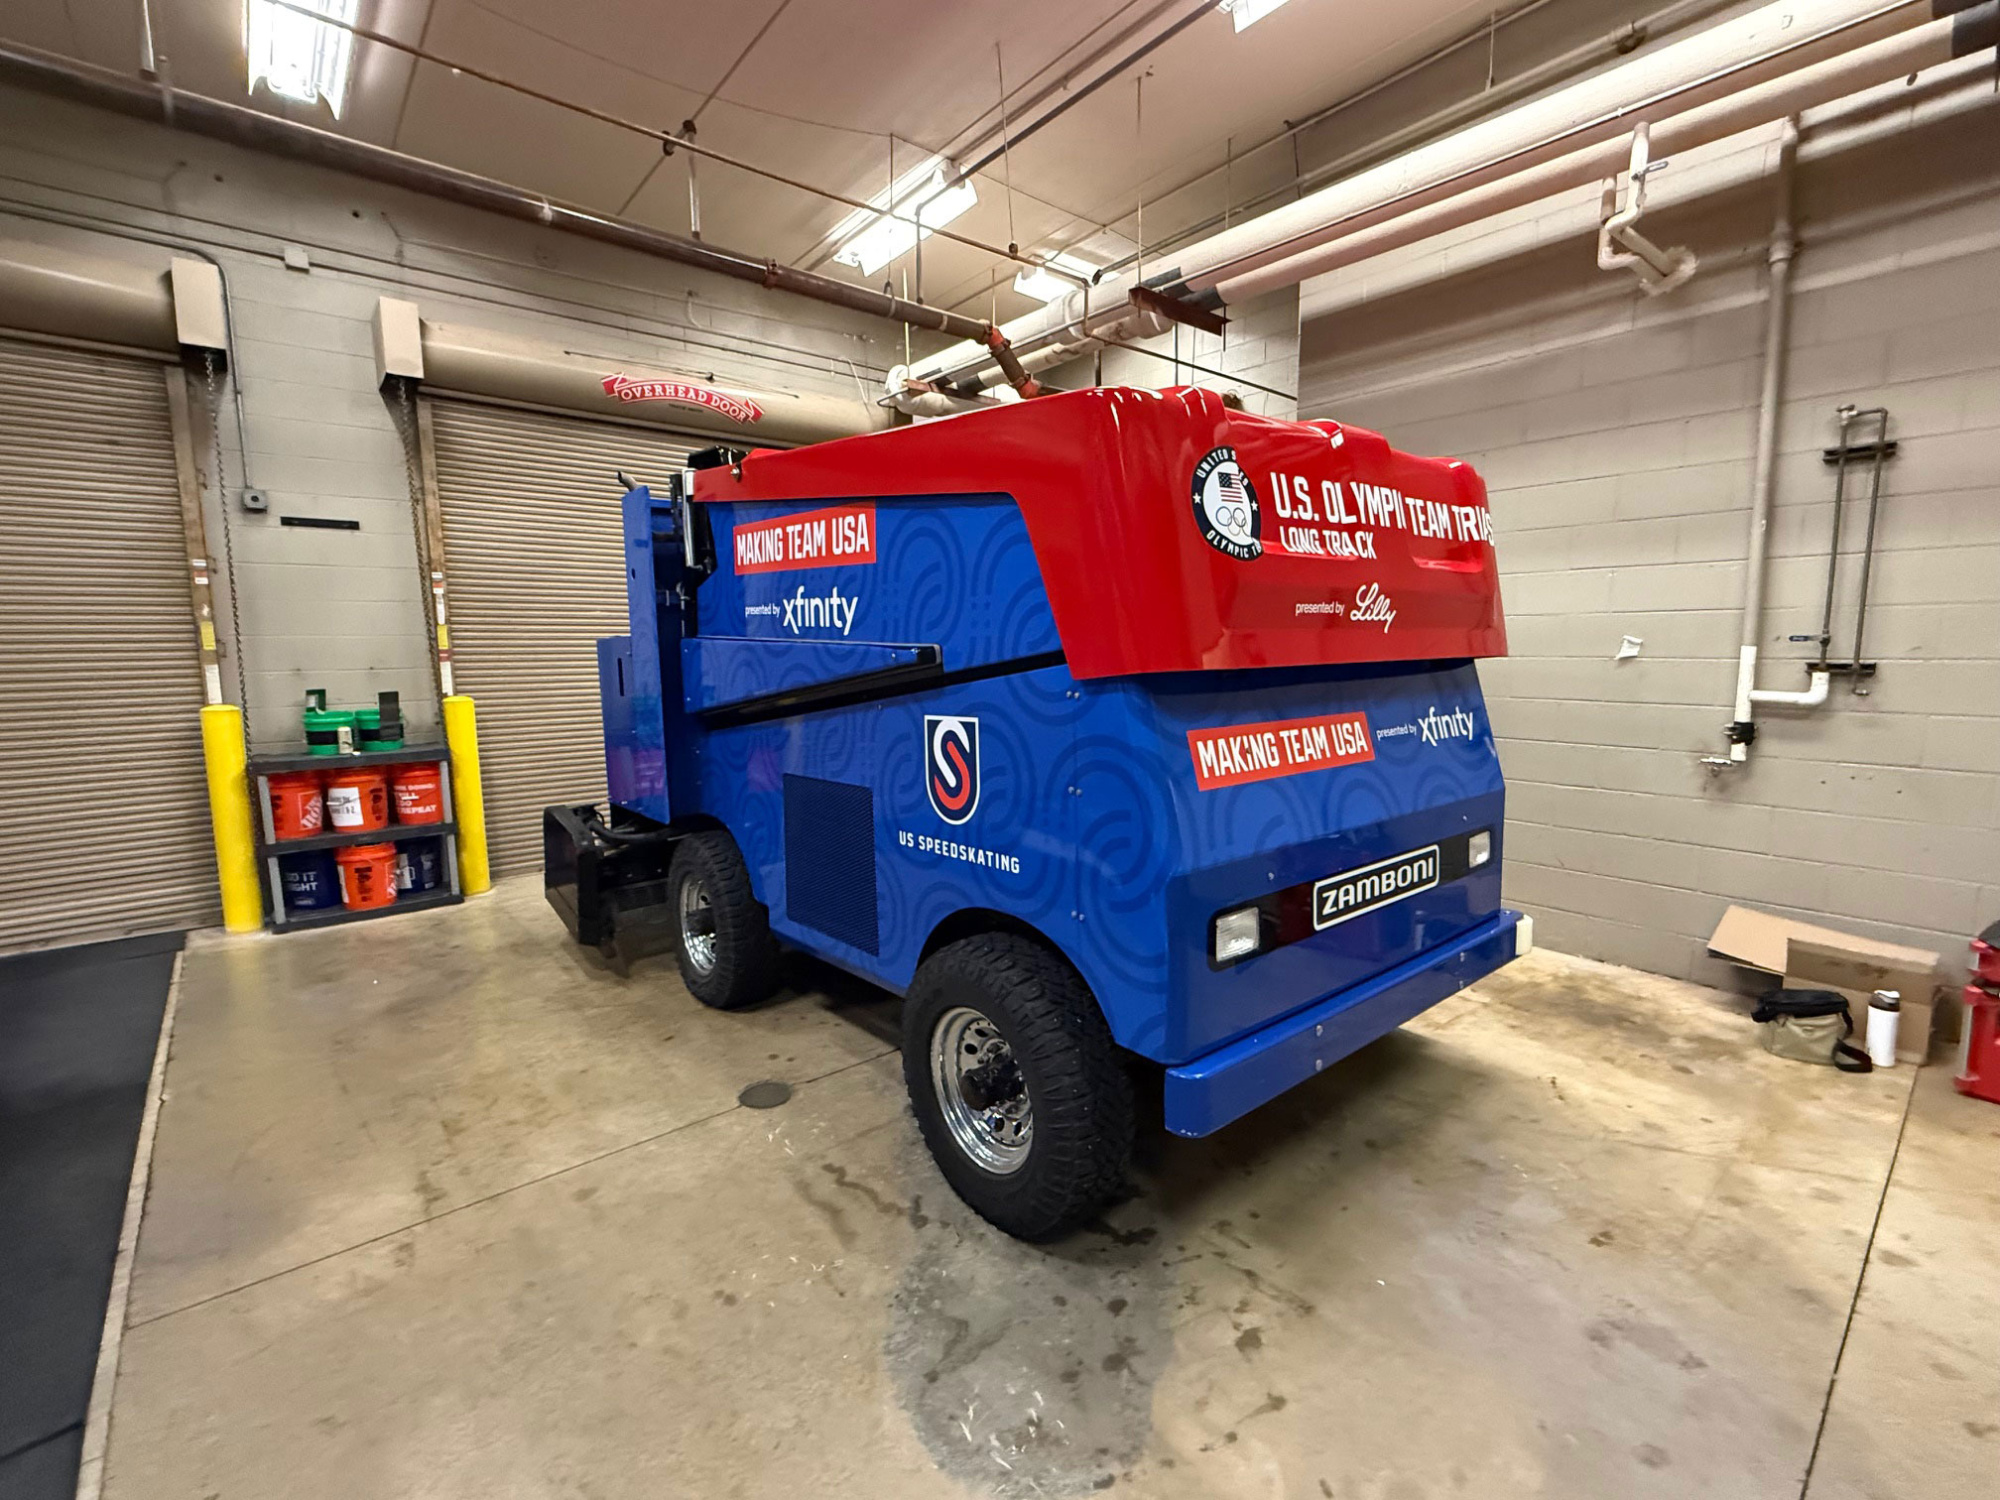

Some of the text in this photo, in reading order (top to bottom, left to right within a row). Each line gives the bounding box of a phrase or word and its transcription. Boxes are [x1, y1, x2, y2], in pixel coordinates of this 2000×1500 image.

[621, 384, 747, 423] OVERHEAD DOOR
[1196, 449, 1229, 479] UNITED
[1270, 472, 1320, 521] U.S.
[1405, 497, 1453, 540] TEAM
[736, 513, 870, 567] MAKING TEAM USA
[1206, 529, 1249, 559] OLYMPIC
[1279, 526, 1325, 555] LONG
[1323, 530, 1378, 560] TRACK
[745, 585, 859, 636] presented by xfinity
[1295, 582, 1397, 634] presented by Lilly
[1376, 705, 1474, 747] presented by xfinity
[1196, 721, 1369, 779] MAKING TEAM USA
[899, 830, 1021, 874] US SPEEDSKATING
[1322, 857, 1434, 916] ZAMBONI
